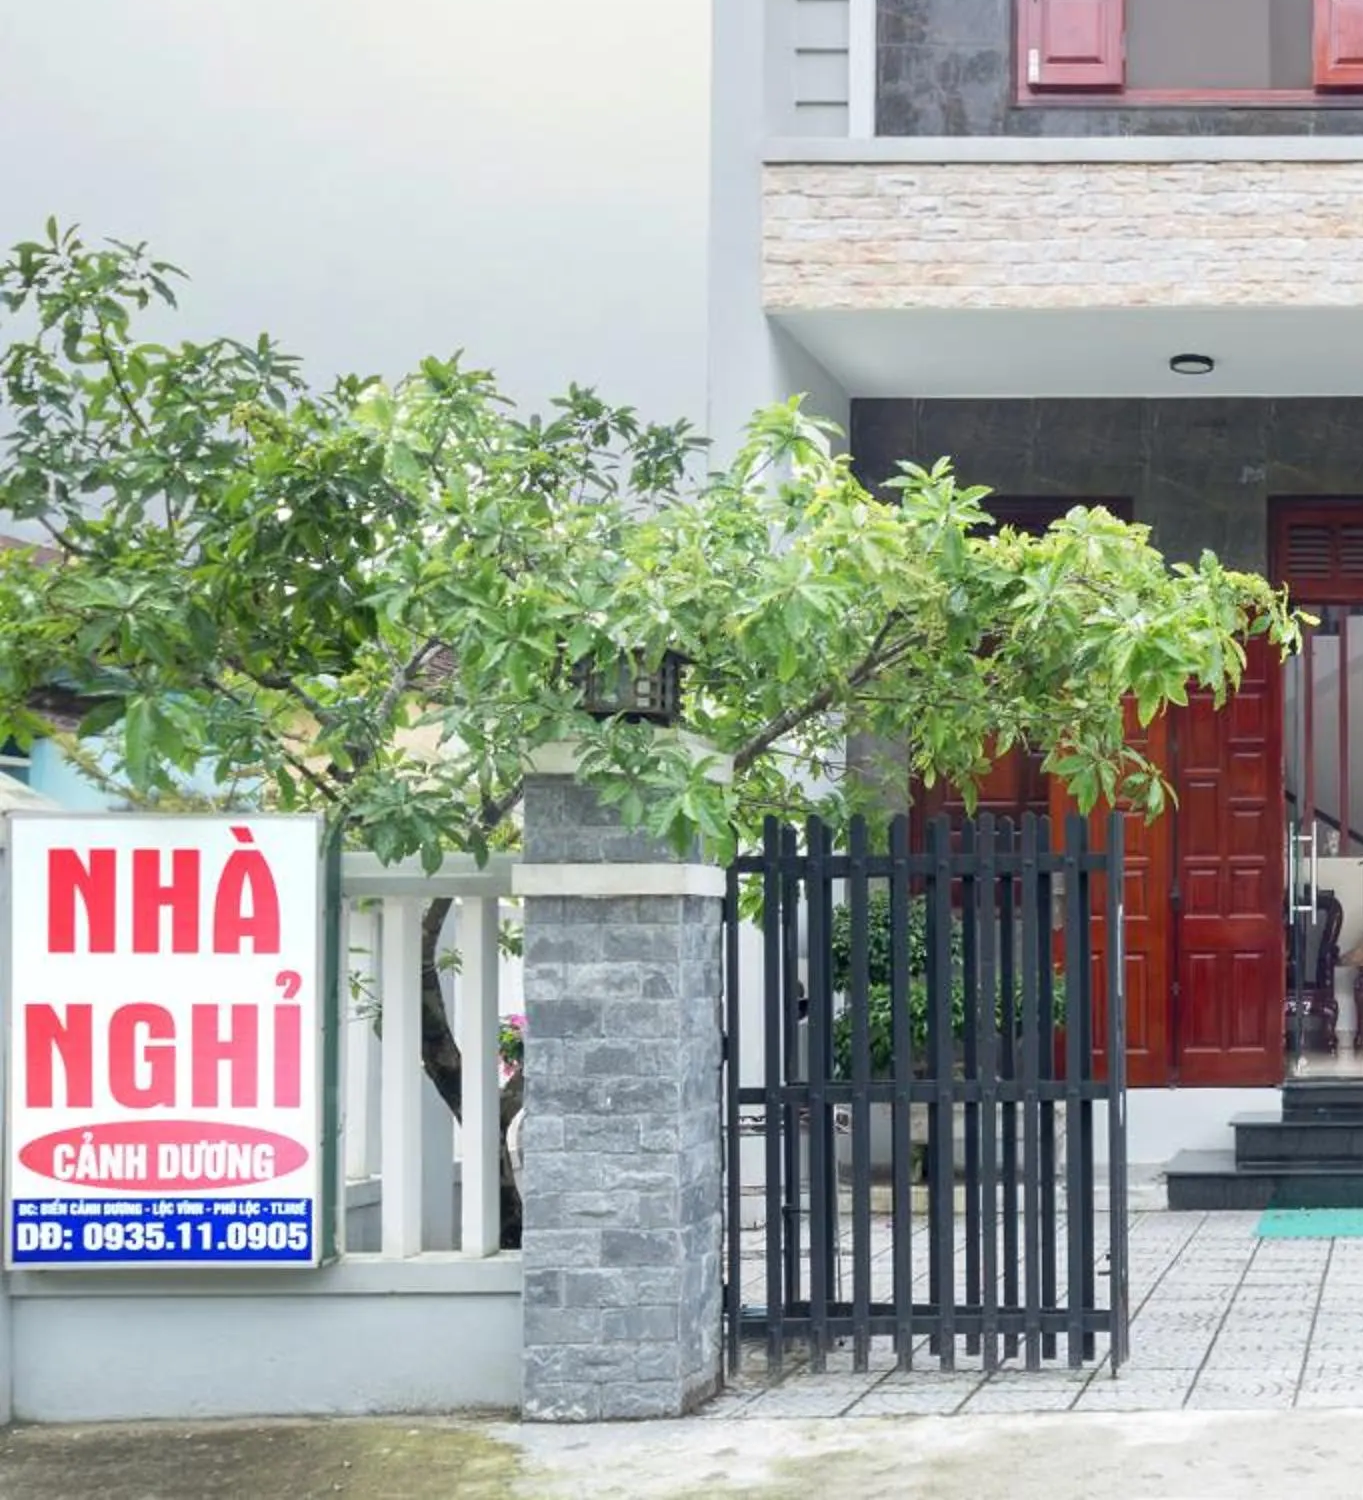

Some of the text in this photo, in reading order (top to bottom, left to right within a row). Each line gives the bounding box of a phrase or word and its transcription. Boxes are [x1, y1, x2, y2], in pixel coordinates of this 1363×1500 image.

[47, 826, 281, 955] NHÀ
[24, 970, 302, 1109] NGHỈ
[53, 1131, 275, 1180] CẢNH DƯƠNG
[69, 1199, 102, 1215] CẢNH
[152, 1200, 175, 1218] LỘC
[213, 1200, 237, 1215] PHÚ
[238, 1200, 261, 1218] LỘC
[17, 1220, 308, 1251] DĐ: 0935.11.0905
